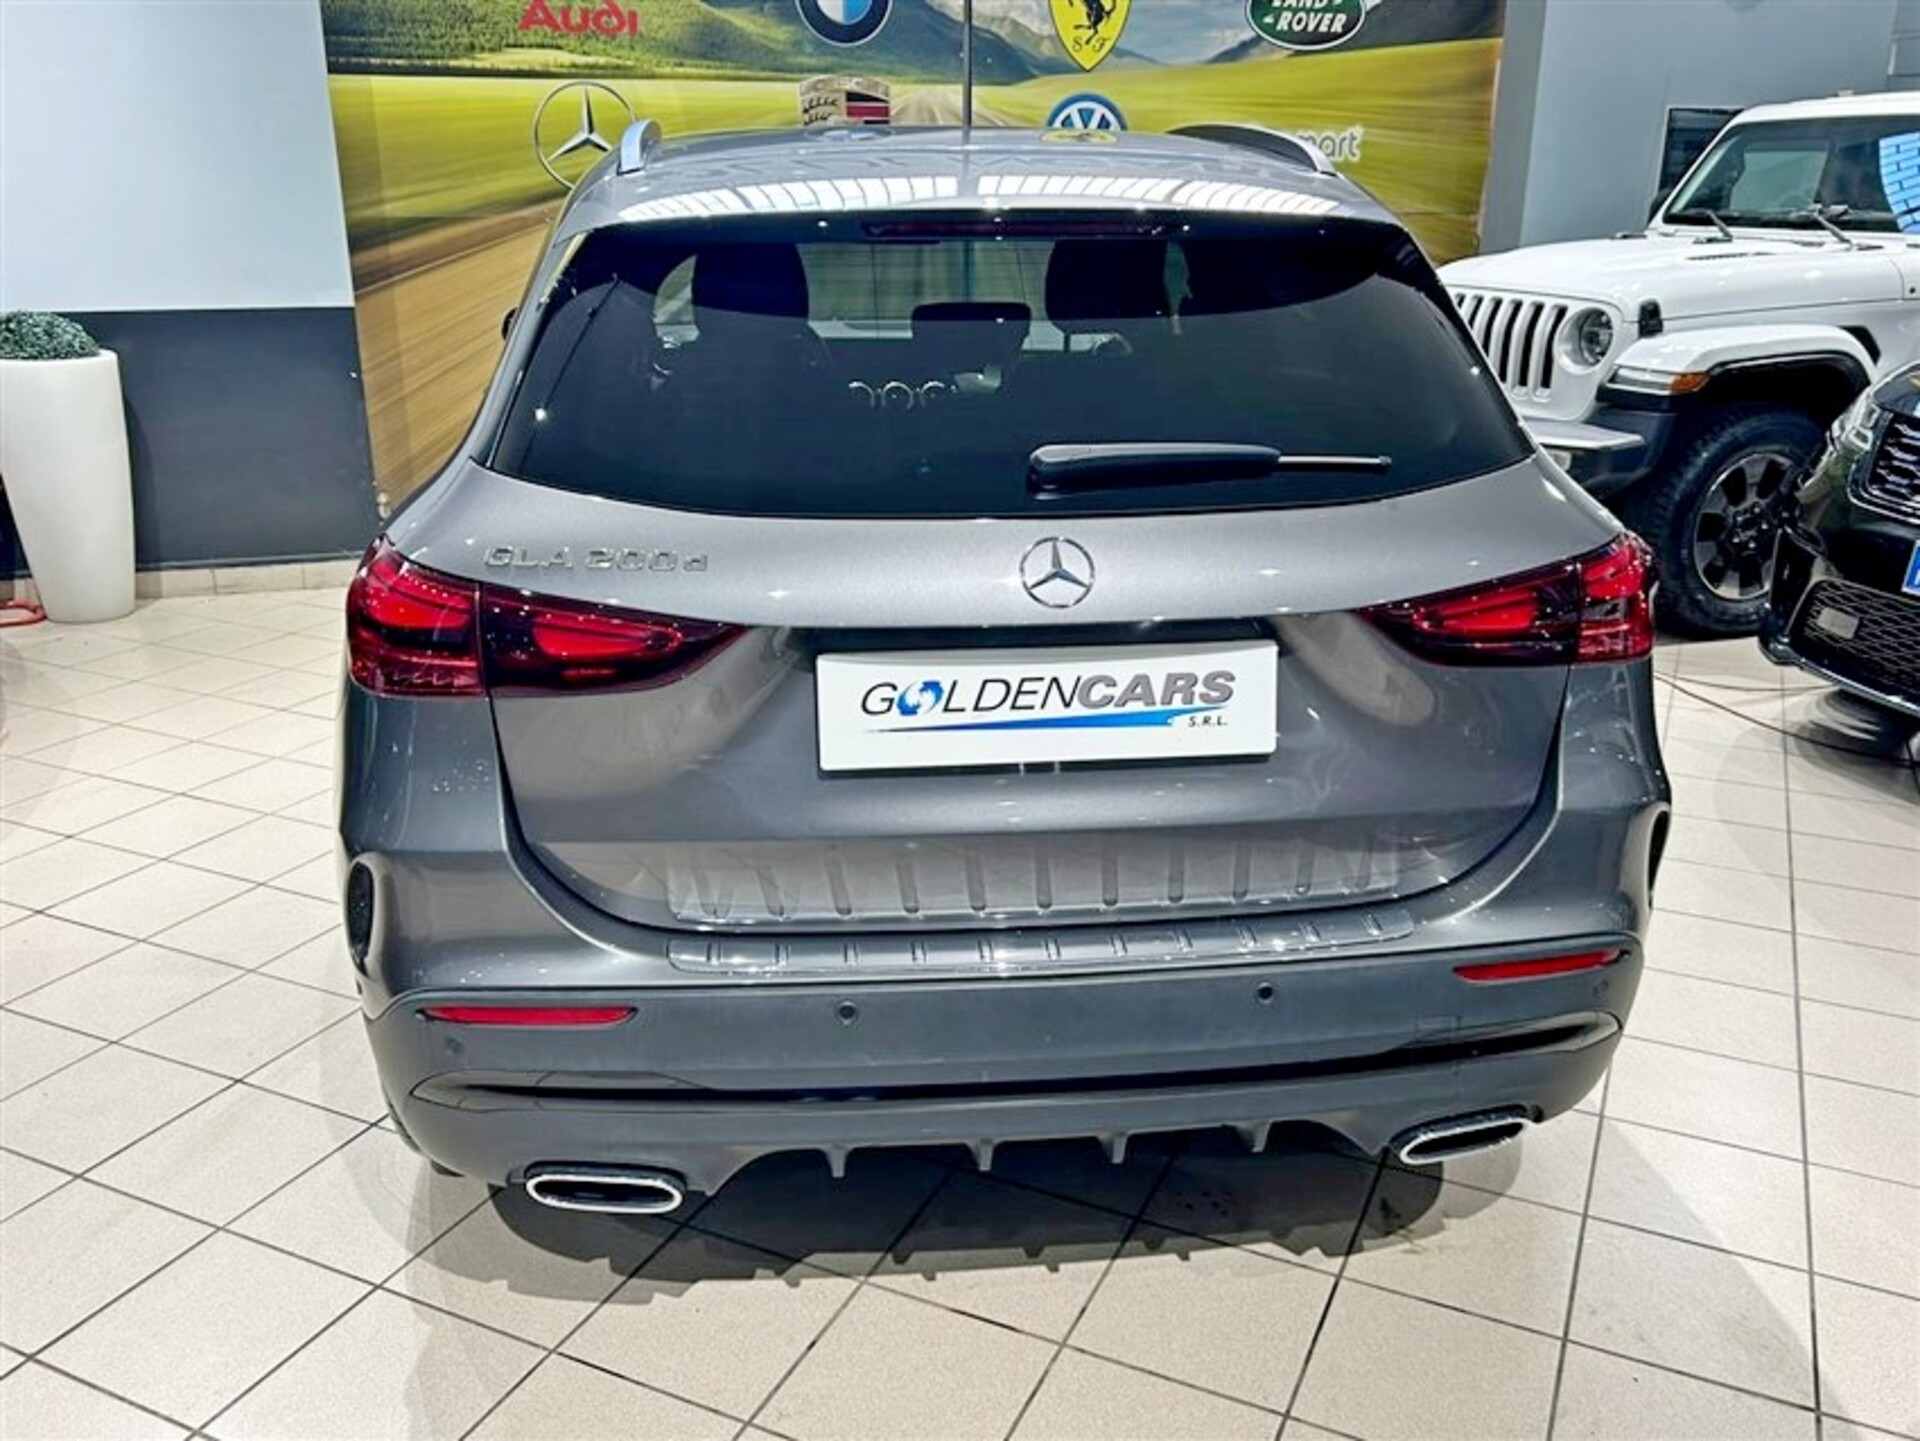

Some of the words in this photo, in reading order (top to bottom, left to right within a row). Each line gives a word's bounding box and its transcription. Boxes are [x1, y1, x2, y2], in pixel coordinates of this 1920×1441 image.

[518, 0, 639, 37] Audi
[1275, 11, 1347, 33] ROVER
[1297, 128, 1361, 159] art
[484, 546, 574, 568] GLA
[1187, 714, 1229, 728] S.R.L.
